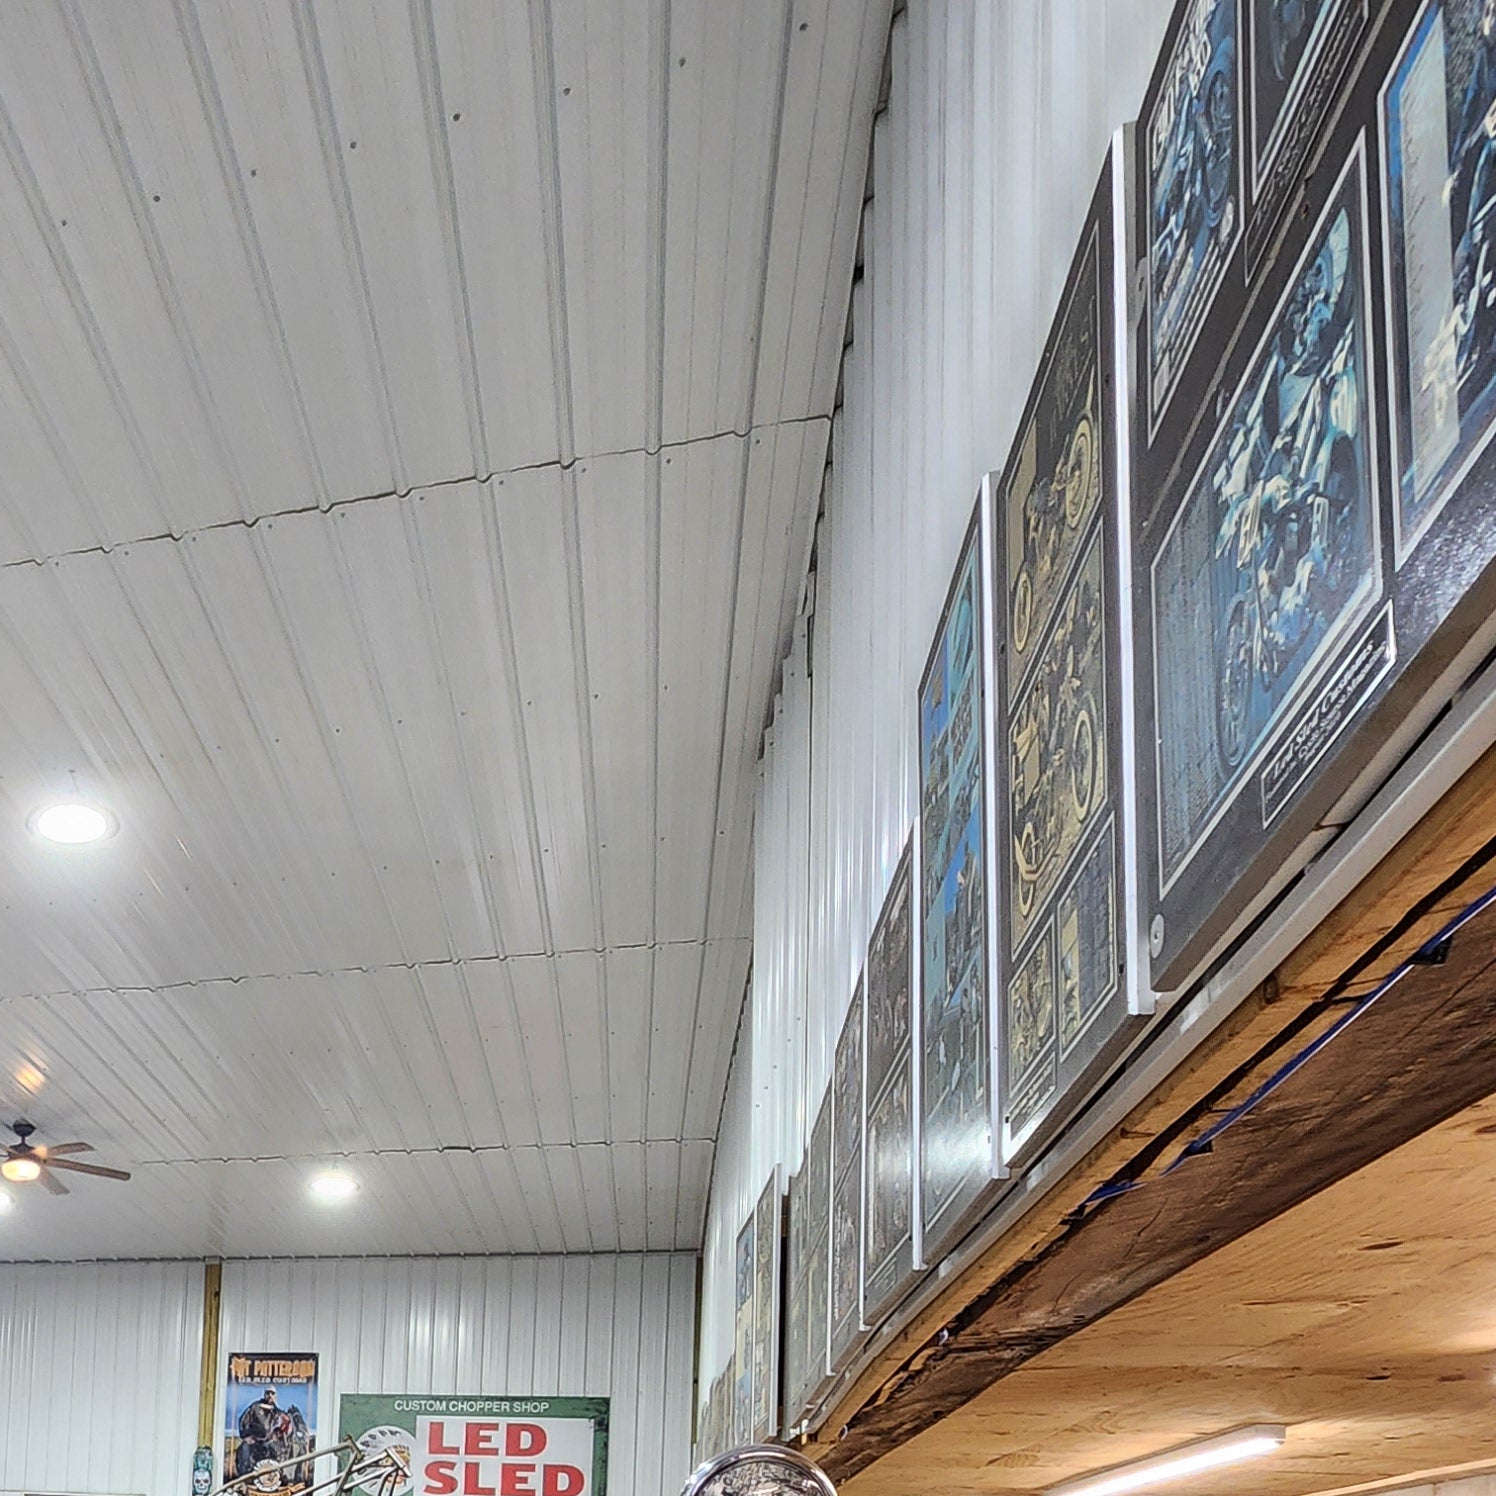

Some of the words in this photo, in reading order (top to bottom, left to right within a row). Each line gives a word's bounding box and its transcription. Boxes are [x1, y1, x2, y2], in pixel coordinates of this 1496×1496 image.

[394, 1400, 446, 1413] CUSTOM
[449, 1400, 510, 1413] CHOPPER
[513, 1401, 550, 1414] SHOP
[428, 1421, 547, 1457] LED
